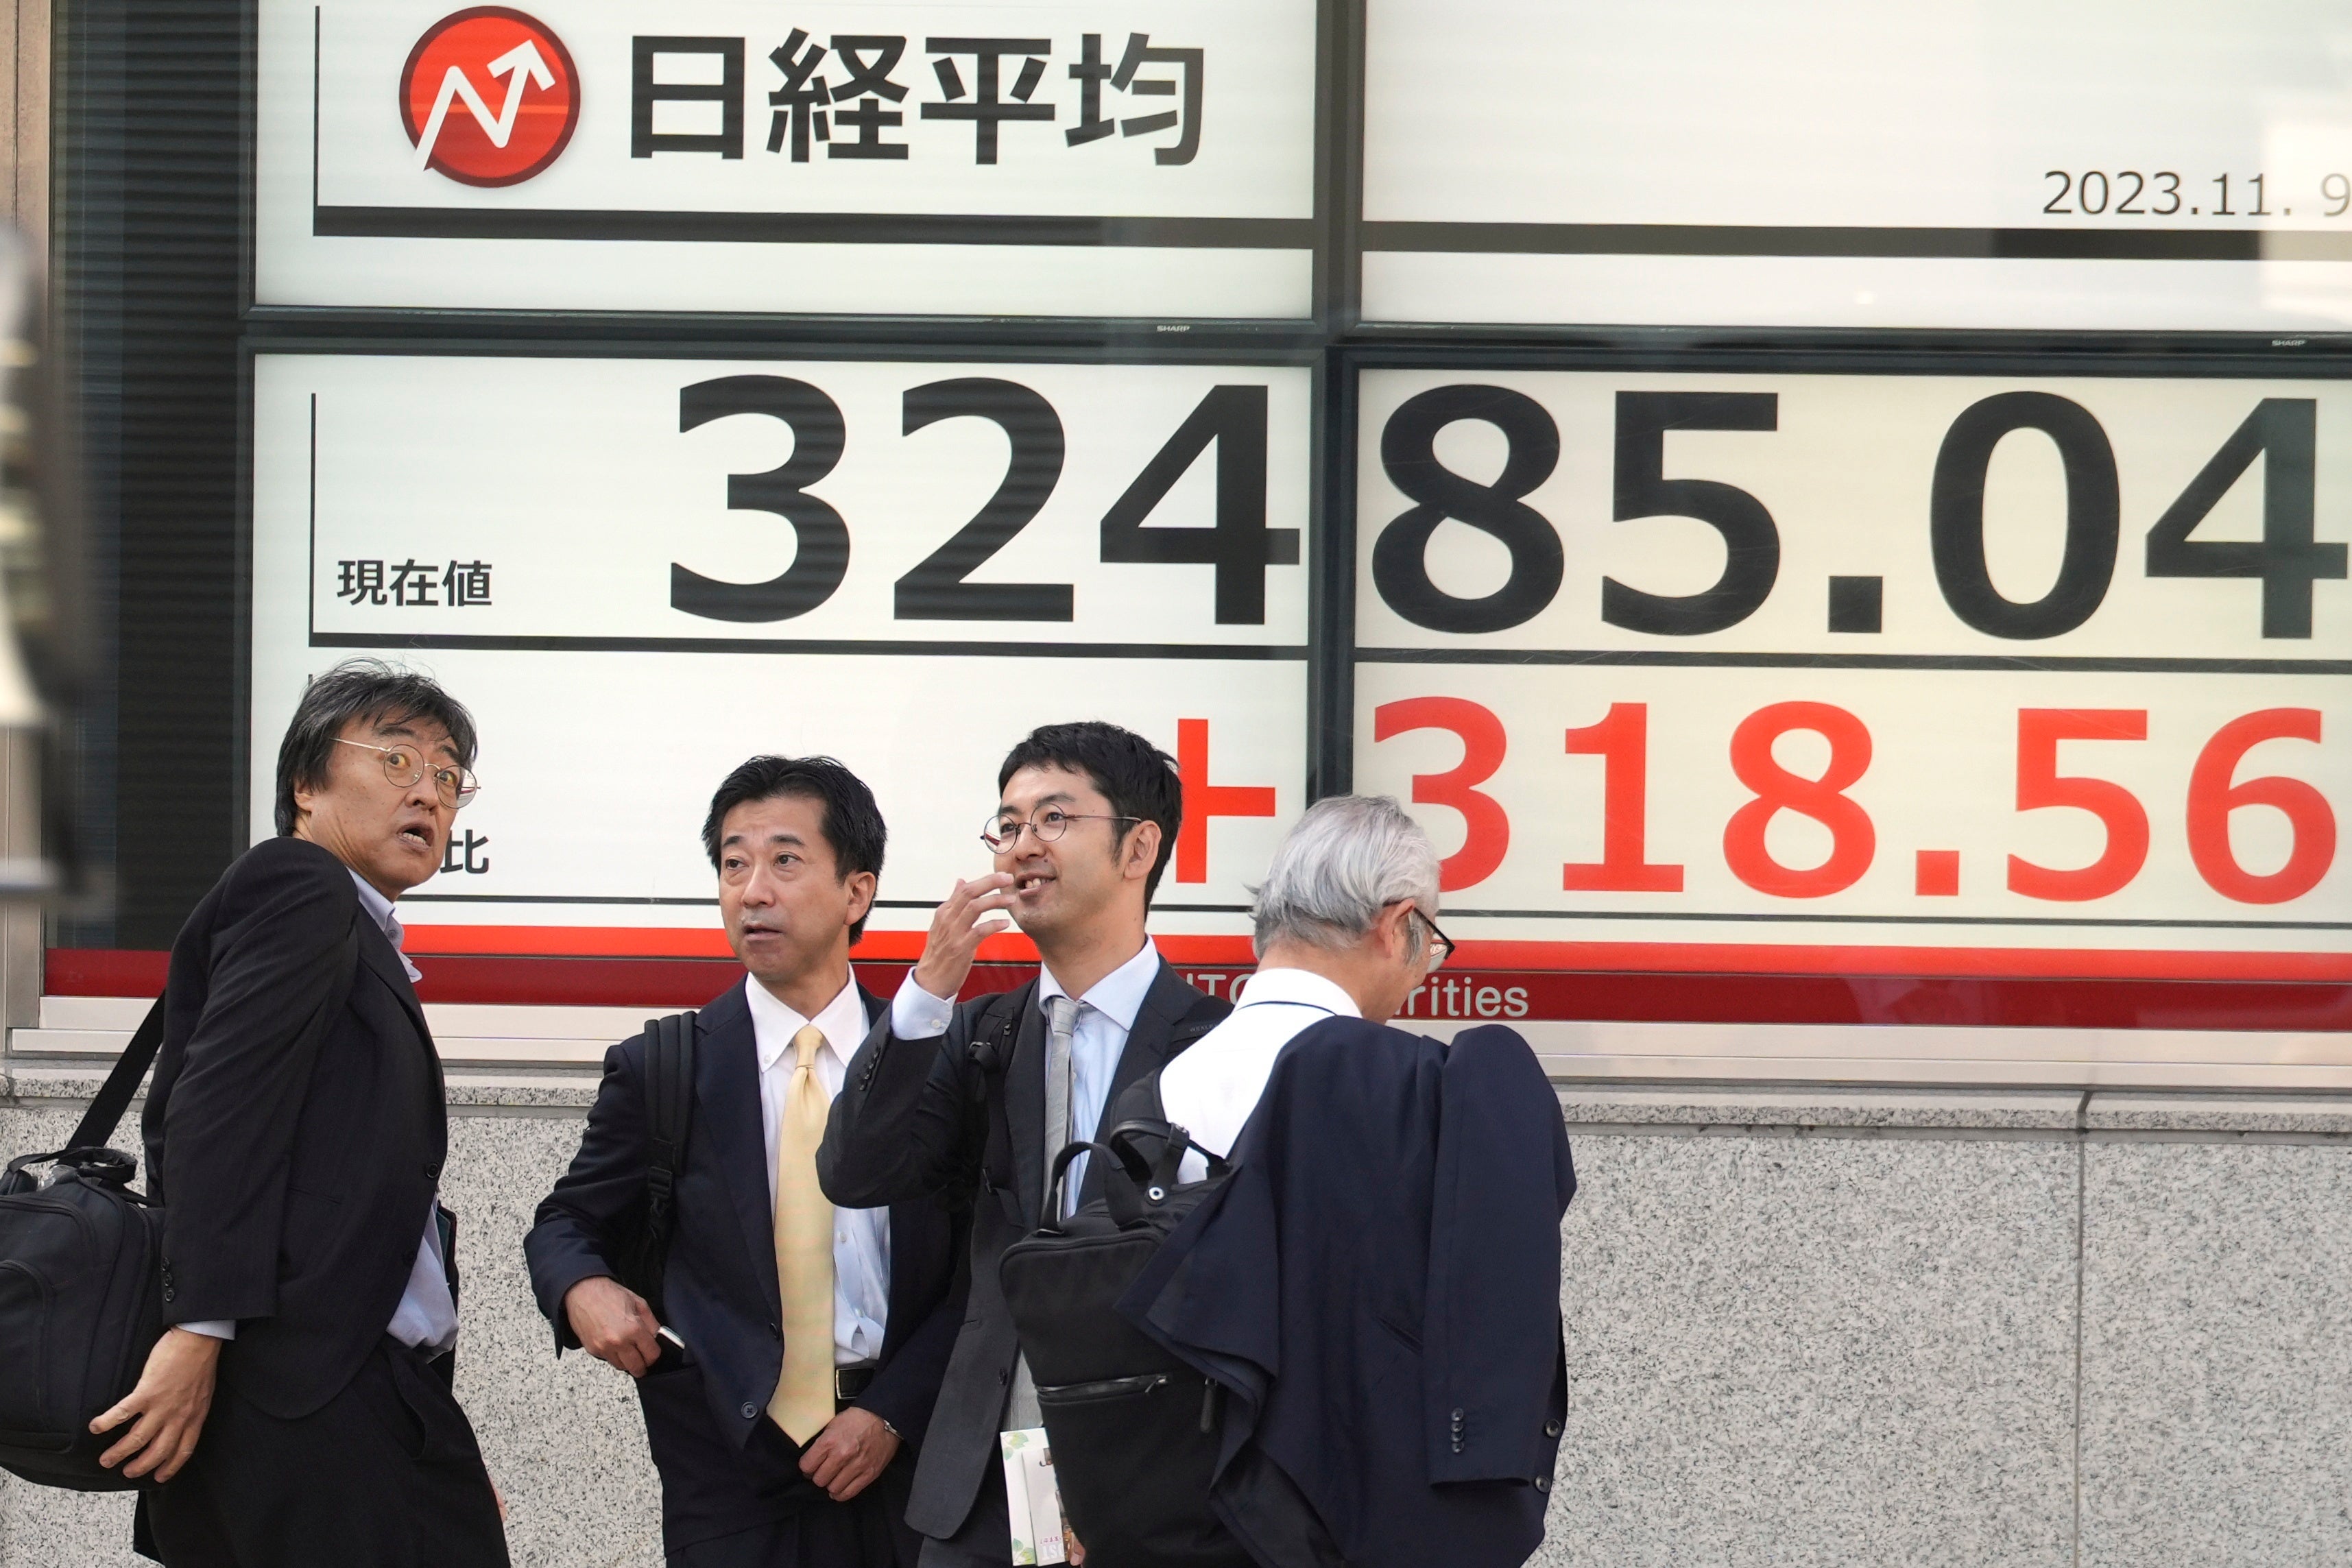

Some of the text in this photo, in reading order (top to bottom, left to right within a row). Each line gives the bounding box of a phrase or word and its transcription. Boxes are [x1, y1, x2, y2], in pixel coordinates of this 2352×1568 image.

[631, 27, 1204, 166] 日経平均
[670, 374, 2349, 641] 32485.04
[337, 558, 492, 607] 現在値
[1395, 976, 1528, 1017] rities
